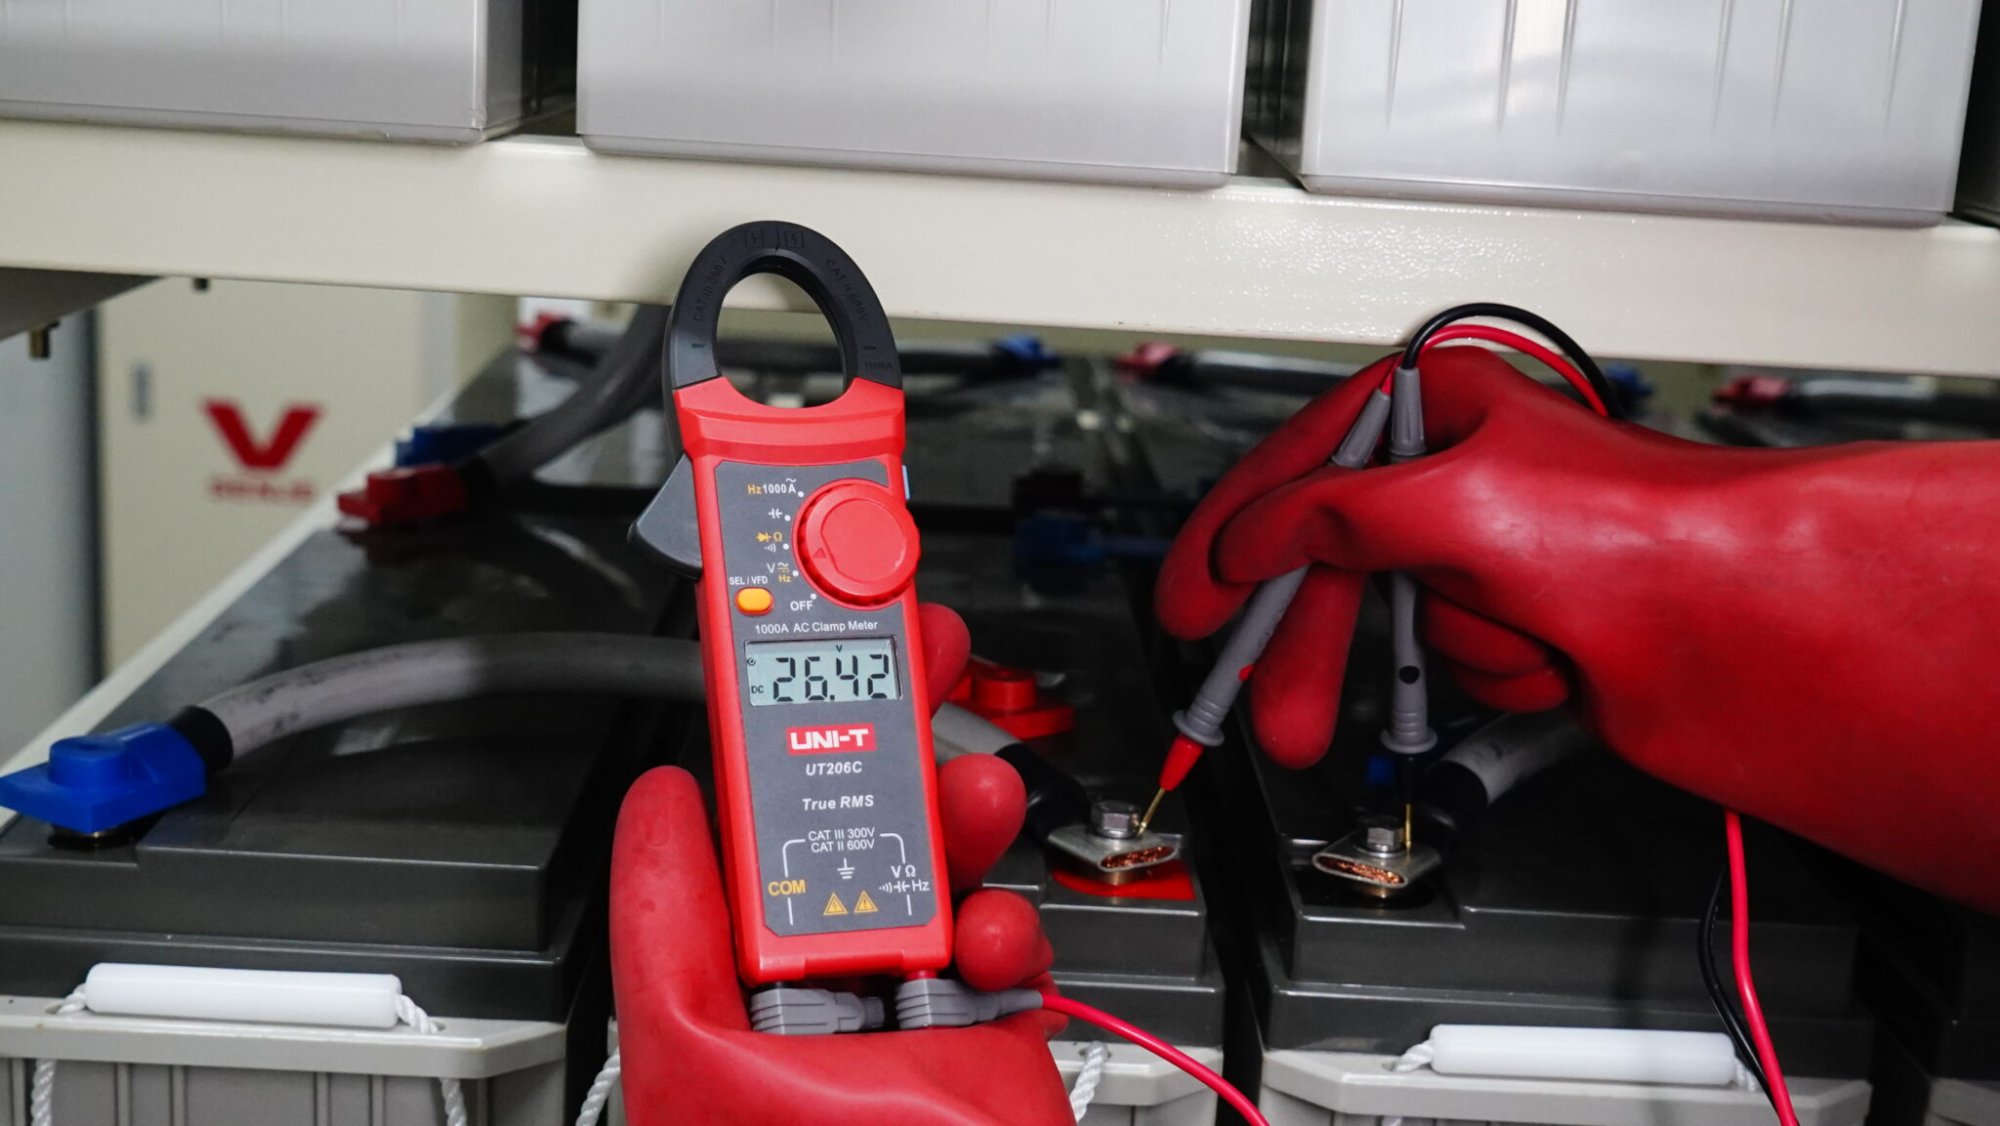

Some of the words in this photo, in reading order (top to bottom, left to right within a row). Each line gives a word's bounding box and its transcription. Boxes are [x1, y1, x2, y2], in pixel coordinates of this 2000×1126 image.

[748, 485, 762, 495] Hz
[767, 563, 776, 573] V
[779, 574, 791, 583] Hz
[790, 601, 813, 611] OFF
[755, 623, 789, 634] 1000A
[794, 622, 810, 633] AC
[812, 620, 846, 632] Clamp
[848, 620, 878, 631] Meter
[836, 644, 843, 652] V
[773, 654, 889, 702] 26.42
[751, 685, 764, 694] DC
[790, 729, 869, 750] UNI-T
[806, 761, 863, 776] UT206C
[802, 798, 836, 811] True
[840, 795, 874, 809] RMS
[808, 829, 831, 841] CAT
[834, 829, 844, 839] III
[848, 827, 875, 838] 300V
[811, 841, 833, 852] CAT
[837, 841, 844, 850] II
[847, 839, 875, 850] 600V
[891, 866, 901, 878] V
[768, 880, 806, 896] COM
[912, 880, 930, 891] Hz
